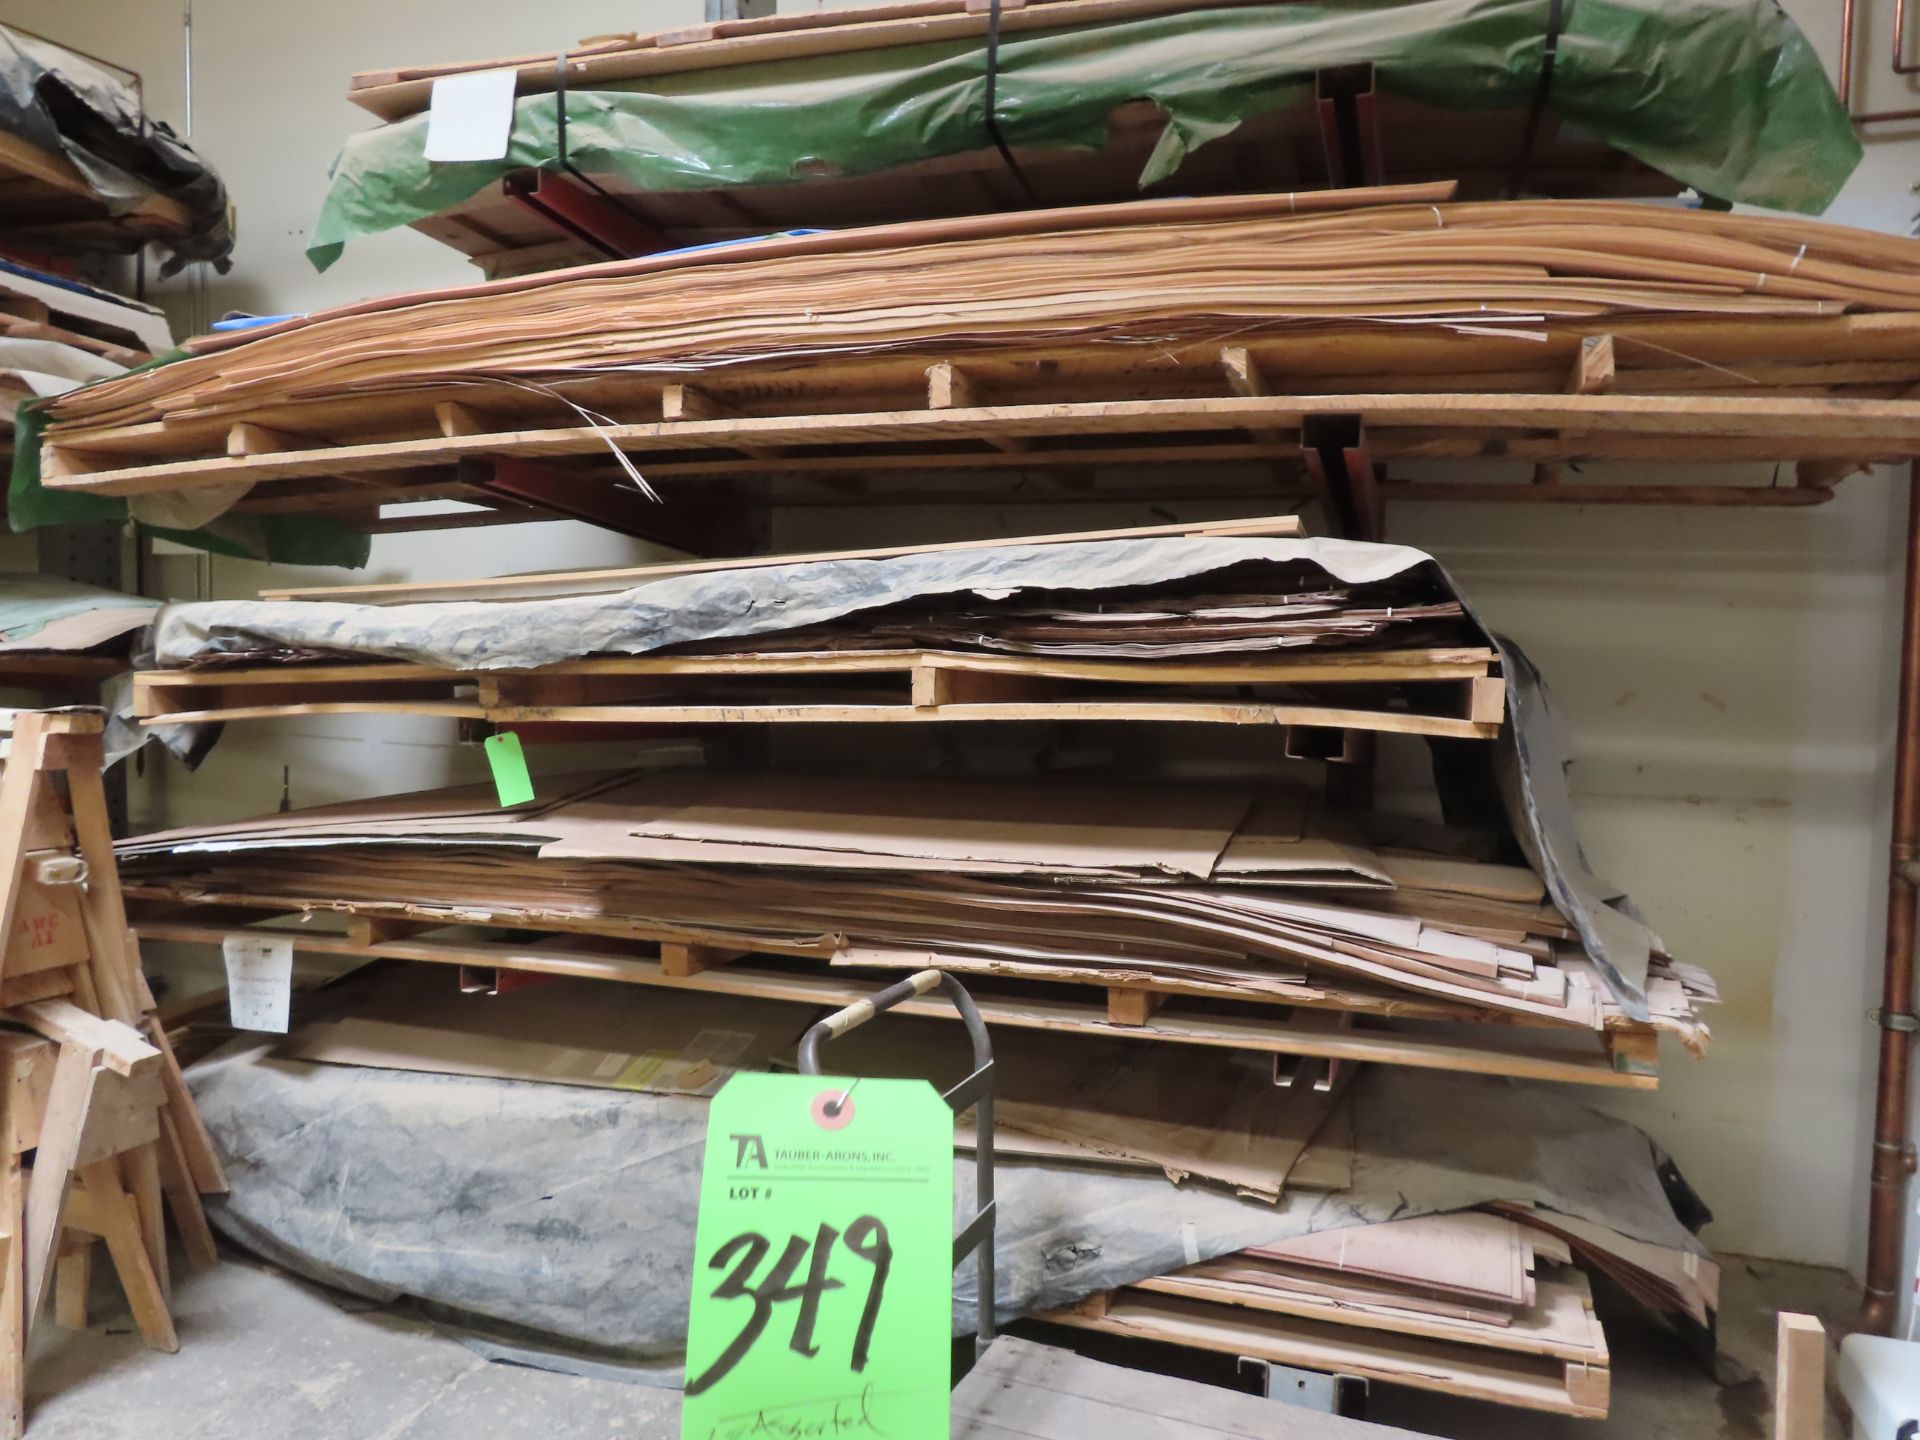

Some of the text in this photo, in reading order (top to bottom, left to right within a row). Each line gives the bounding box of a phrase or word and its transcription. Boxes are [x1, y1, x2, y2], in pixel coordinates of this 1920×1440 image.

[729, 1133, 769, 1170] TA
[729, 1186, 773, 1200] LOT #
[684, 1214, 893, 1397] 349
